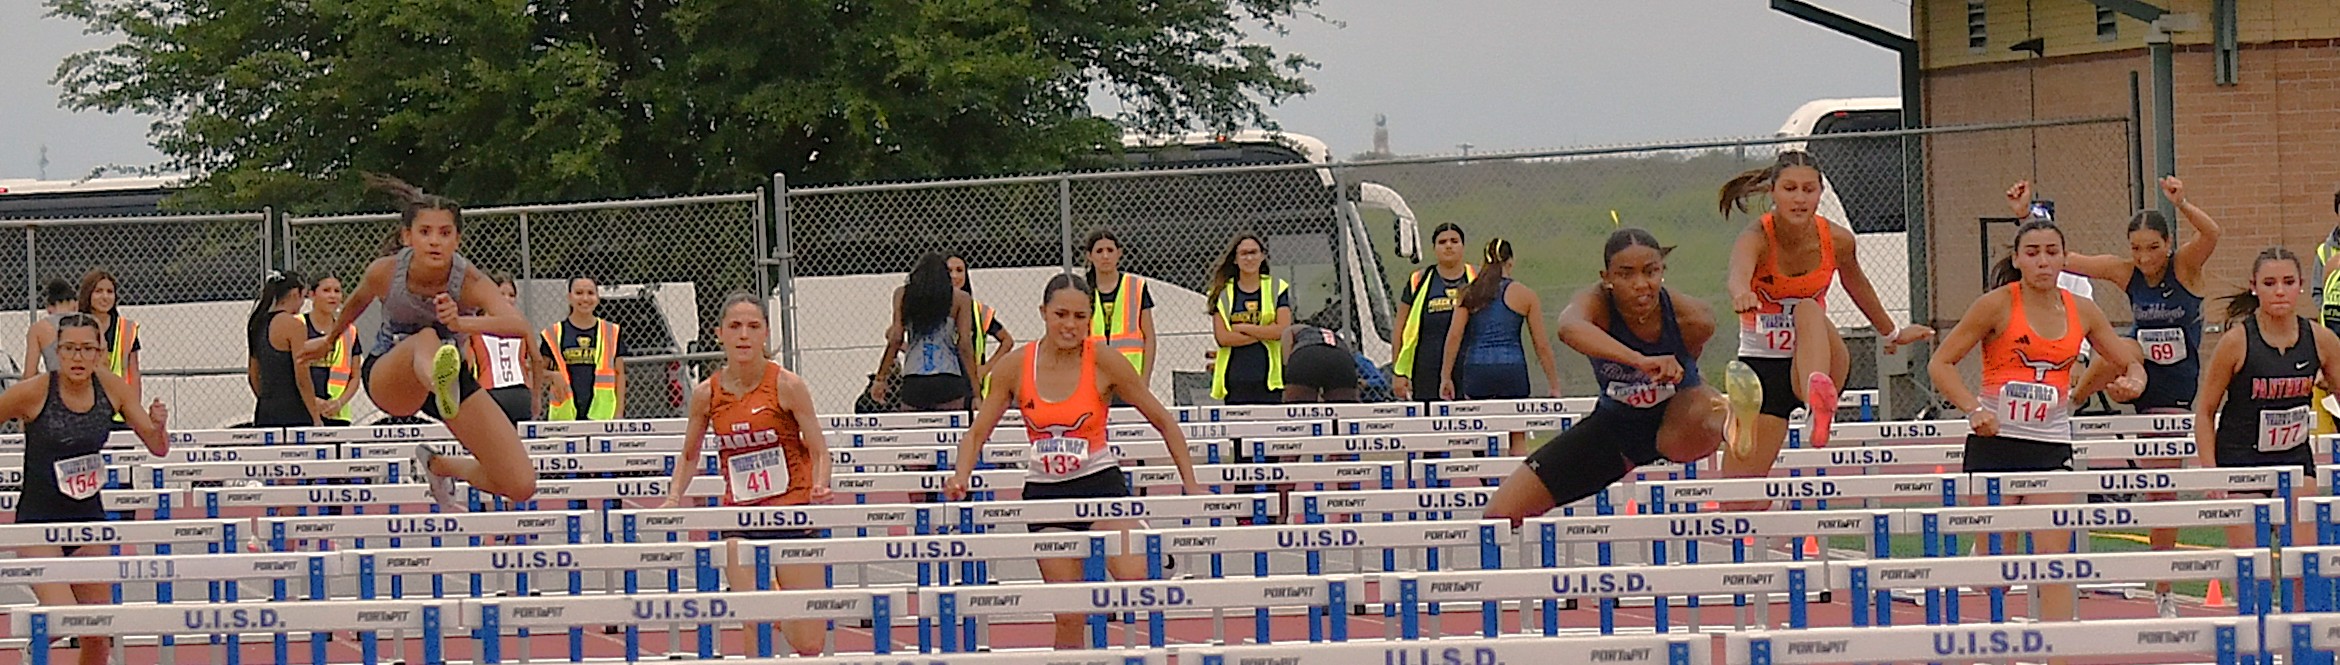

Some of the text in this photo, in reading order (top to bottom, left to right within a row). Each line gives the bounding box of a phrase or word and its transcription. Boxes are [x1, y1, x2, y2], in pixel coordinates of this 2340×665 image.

[1765, 330, 1797, 349] 12
[2151, 343, 2173, 360] 69
[1286, 407, 1338, 417] U.I.S.D.
[1516, 402, 1567, 413] U.I.S.D.
[2008, 400, 2047, 422] 114
[604, 423, 655, 433] U.I.S.D.
[831, 418, 882, 427] U.I.S.D.
[1432, 419, 1488, 431] U.I.S.D.
[2153, 418, 2192, 431] U.I.S
[170, 434, 197, 443] S.D.
[373, 428, 424, 438] U.I.S.D.
[1880, 425, 1941, 437] U.I.S.D.
[2268, 423, 2300, 445] 177
[1345, 438, 1406, 450] U.I.S.D.
[2135, 443, 2195, 456] U.I.S.D
[186, 451, 242, 461] U.I.S.D.
[1831, 450, 1898, 464] U.I.S.D.
[245, 465, 306, 477] U.I.S.D.
[534, 459, 583, 470] .I.S.D.
[1040, 454, 1080, 474] 133
[747, 470, 772, 493] 41
[1222, 469, 1289, 481] U.I.S.D.
[2101, 474, 2176, 489] U.I.S.D.
[66, 471, 97, 495] 154
[617, 482, 671, 496] U.I.S.
[1765, 482, 1841, 497] U.I.S.D.
[309, 490, 377, 502] U.I.S.D.
[1418, 493, 1489, 508] U.I.S.D
[1075, 502, 1150, 518] U.I.S.D.
[2052, 509, 2138, 526] U.I.S.D.
[387, 519, 464, 533] U.I.S.D.
[738, 511, 814, 527] U.I.S.D.
[1670, 518, 1757, 535] U.I.S.D.
[45, 527, 122, 542] U.I.S.D.
[1278, 530, 1364, 547] U.I.S.D.
[885, 541, 973, 559] U.I.S.D.
[492, 551, 579, 568] U.I.S.D.
[119, 560, 180, 579] U.I.S.D.
[2001, 560, 2101, 581] U.I.S.D.
[1552, 573, 1652, 593] U.I.S.D.
[1092, 586, 1193, 607] U.I.S.D.
[634, 599, 735, 618] U.I.S.D.
[185, 609, 286, 629] U.I.S.D.
[1933, 630, 2053, 655] U.I.S.D.
